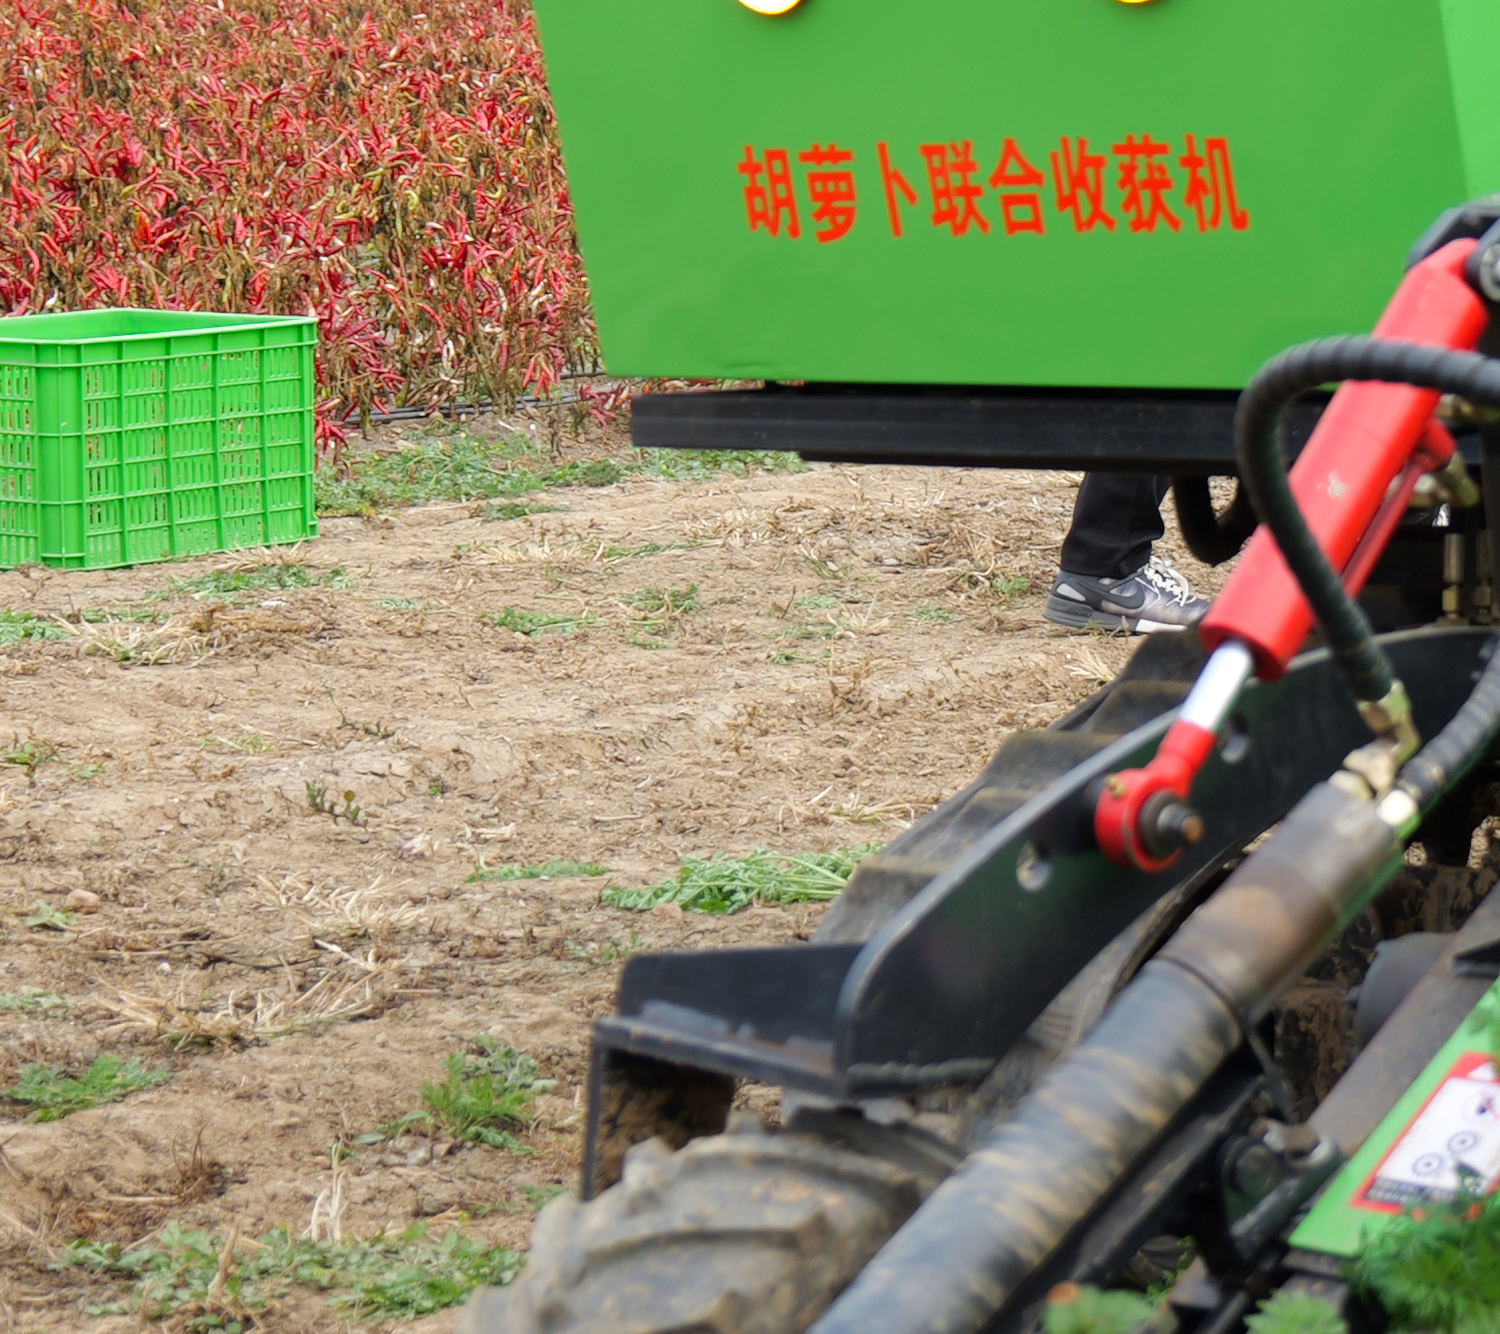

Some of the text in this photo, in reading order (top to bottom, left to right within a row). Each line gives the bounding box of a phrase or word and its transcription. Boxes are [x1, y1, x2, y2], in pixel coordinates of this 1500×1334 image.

[736, 132, 1250, 244] 胡萝卜联合收获机
